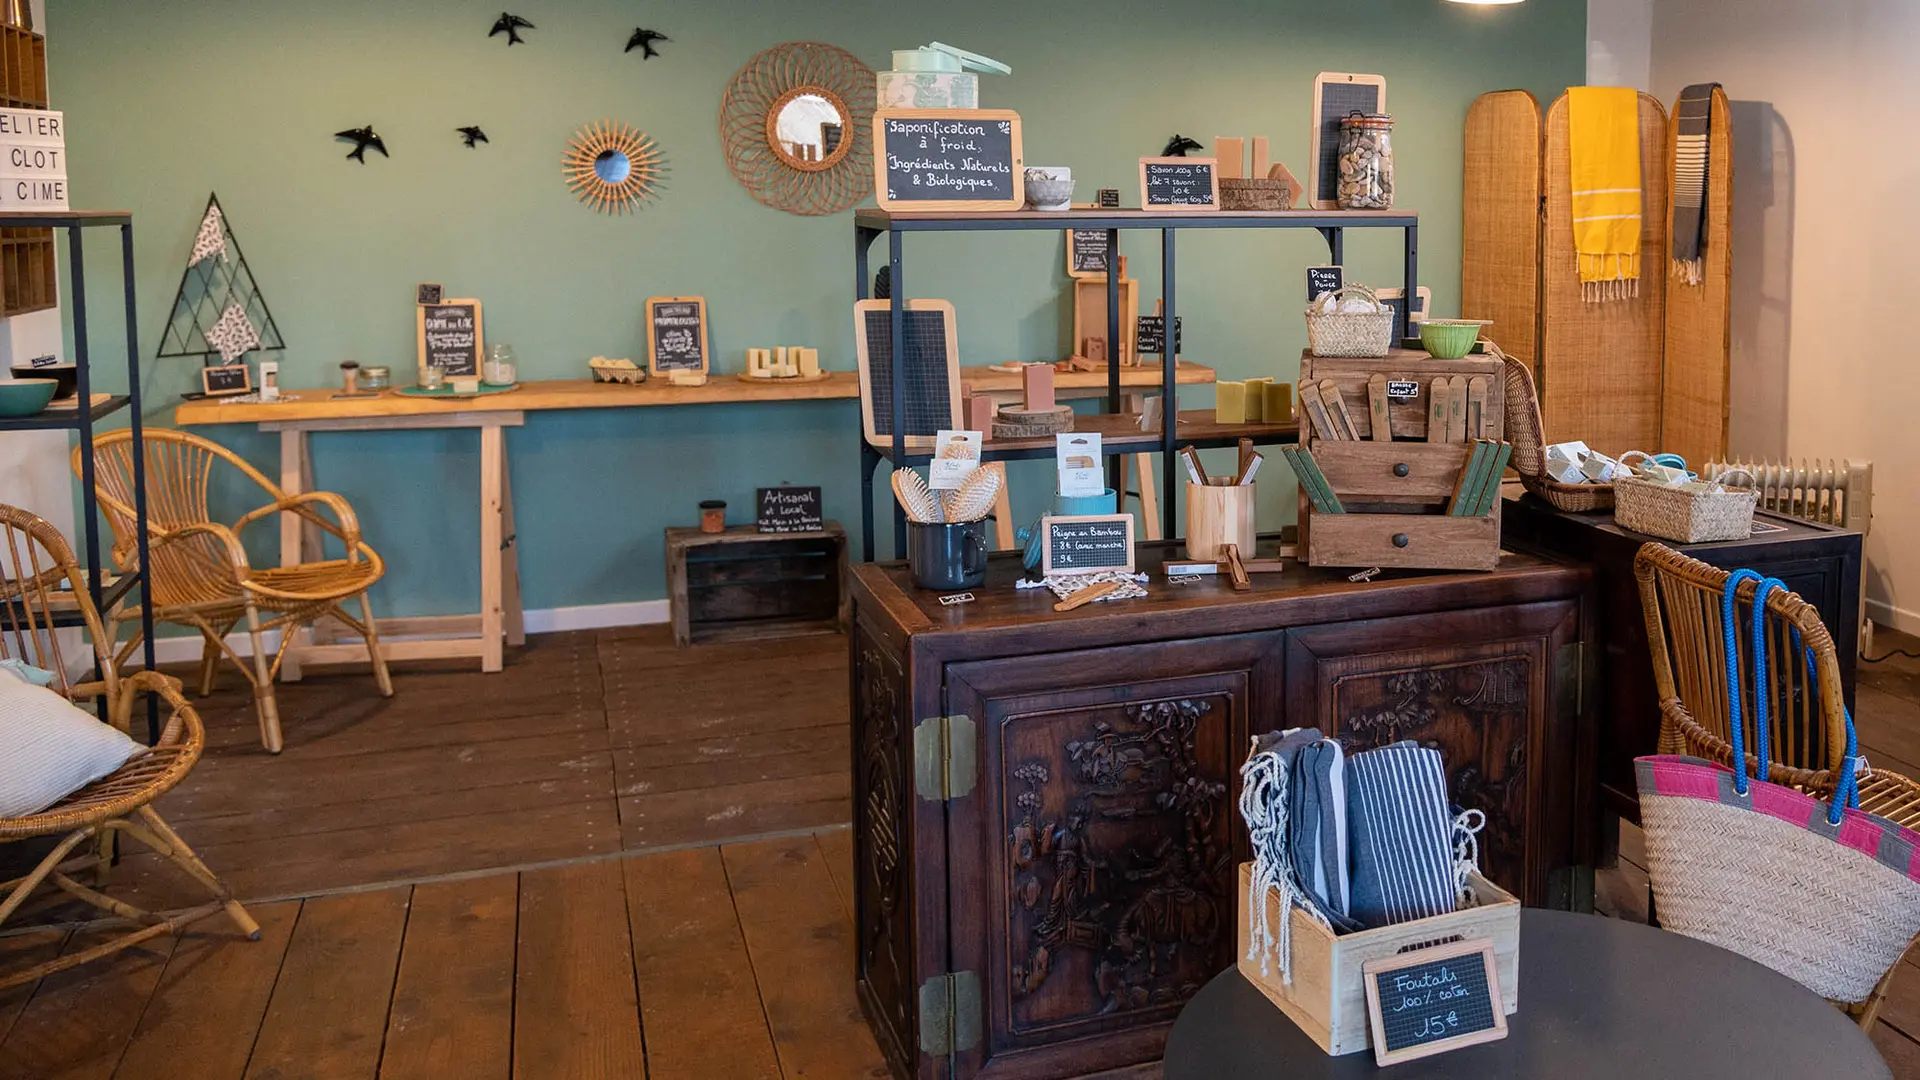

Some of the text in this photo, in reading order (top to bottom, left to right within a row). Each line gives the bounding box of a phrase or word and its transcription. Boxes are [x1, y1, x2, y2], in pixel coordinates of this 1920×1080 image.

[0, 115, 60, 137] ELIER
[889, 121, 985, 138] Saponification
[12, 148, 58, 169] CLOT
[889, 156, 1010, 173] Ingrédients Naturels
[1151, 165, 1173, 174] Savon
[17, 181, 64, 200] CIME
[913, 173, 993, 191] & Biologiques
[764, 490, 814, 504] Artisanal
[780, 504, 807, 515] Local
[1052, 525, 1076, 540] Peigne
[1090, 526, 1122, 536] Bambou
[1440, 984, 1470, 1000] coton
